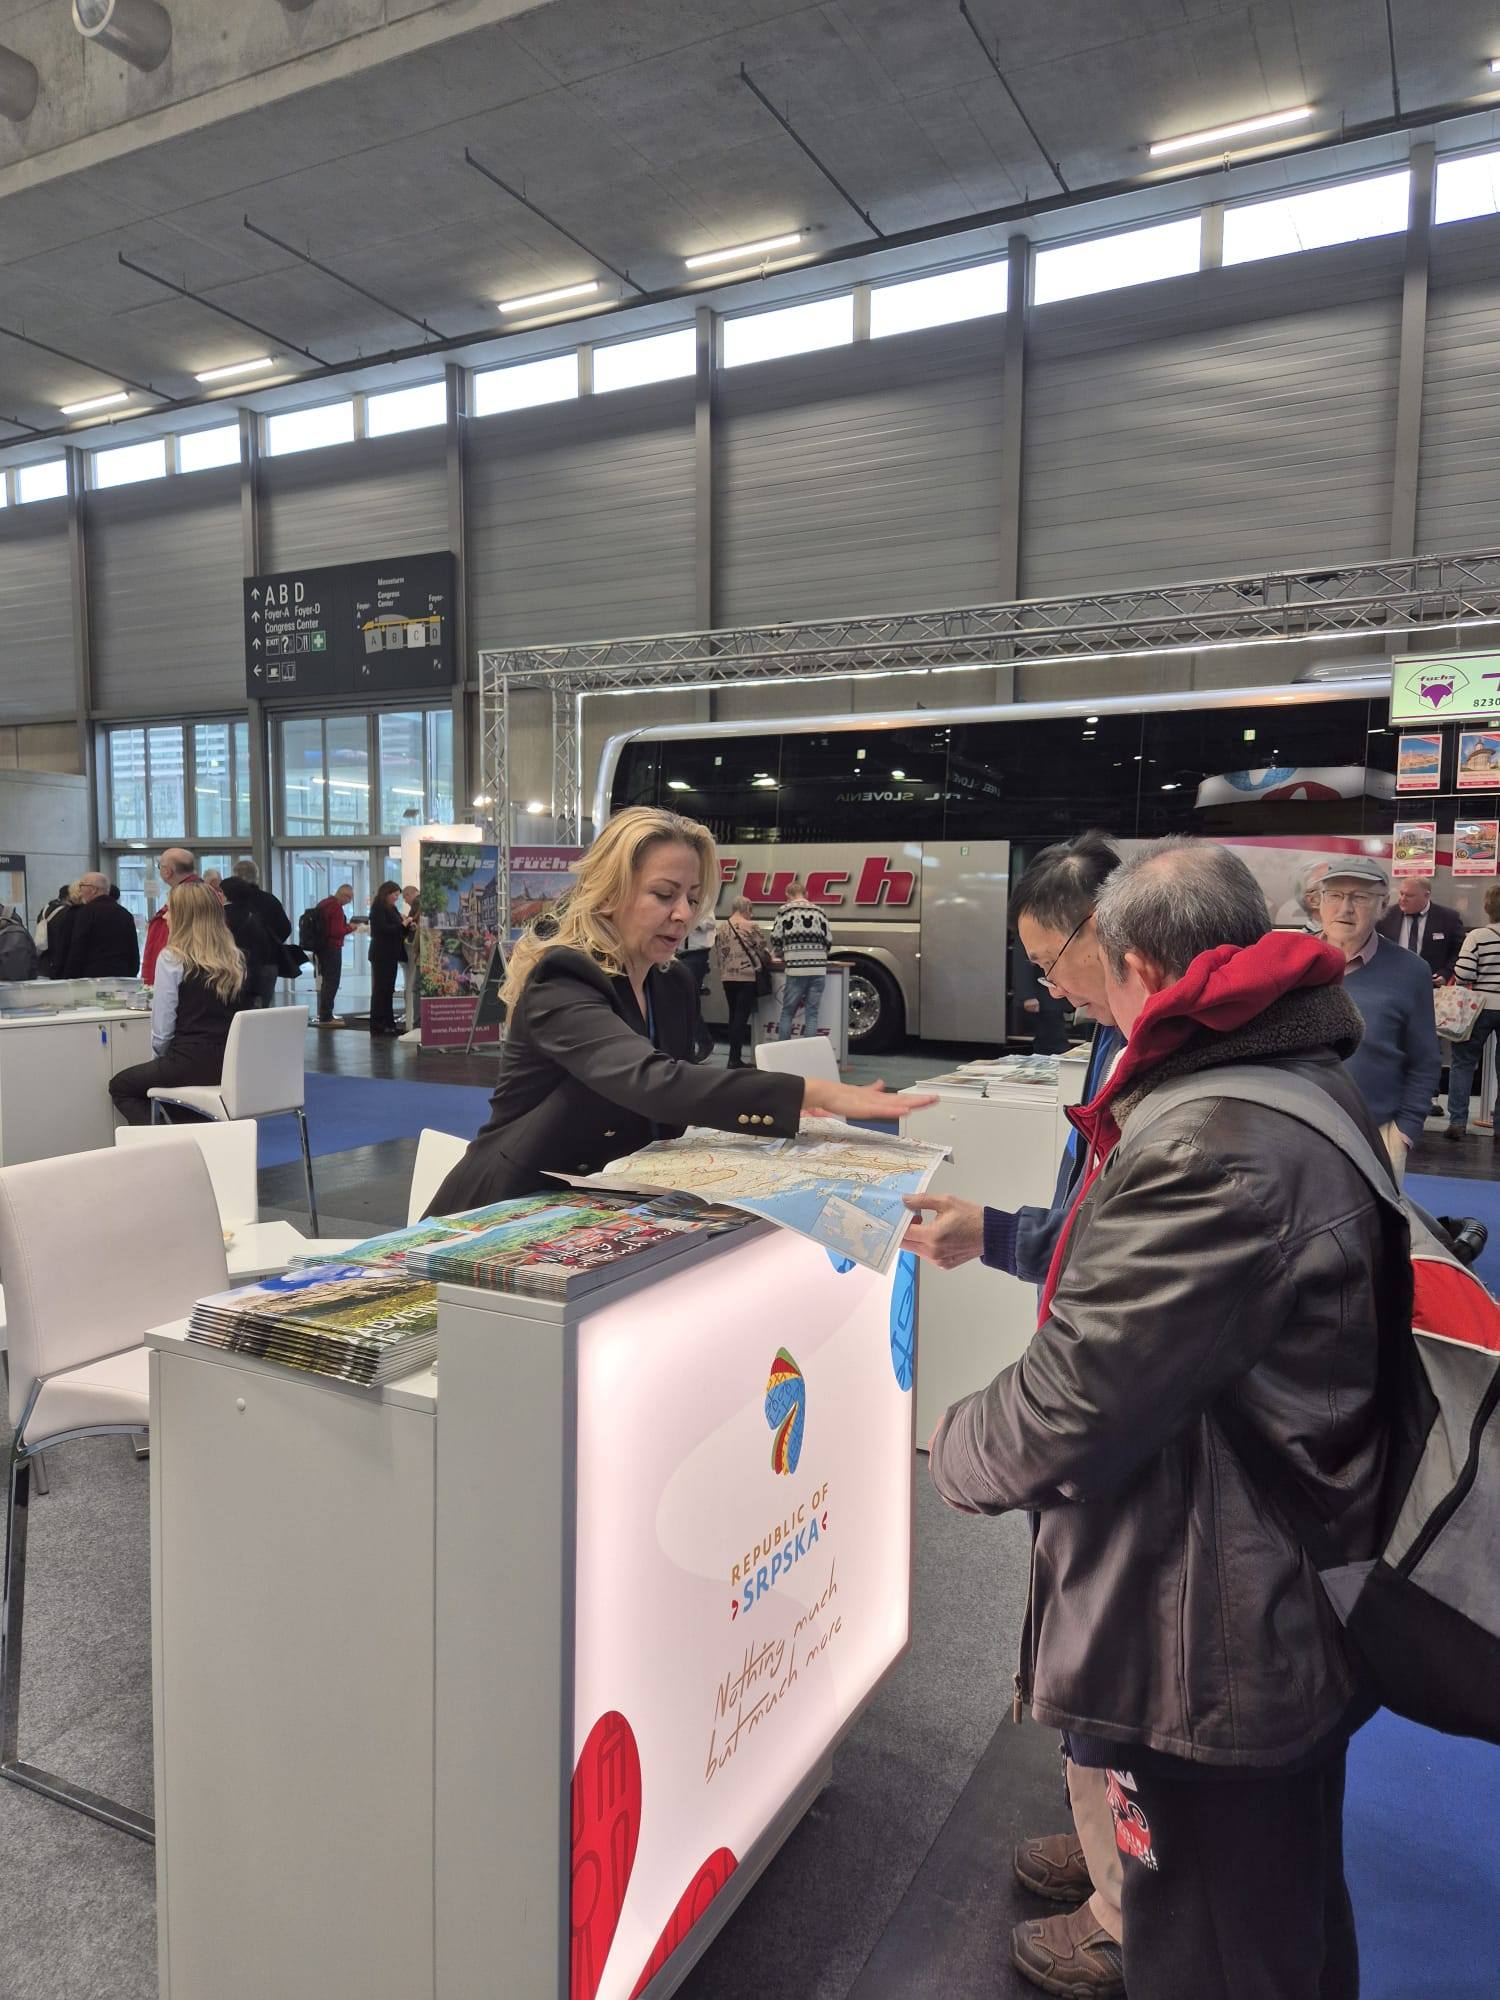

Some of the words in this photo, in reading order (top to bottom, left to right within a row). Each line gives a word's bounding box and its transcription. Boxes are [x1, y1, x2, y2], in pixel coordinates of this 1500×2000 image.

[264, 606, 290, 621] Foyer-A
[294, 602, 321, 618] Foyer-D
[265, 585, 276, 606] A
[279, 583, 288, 605] B
[294, 582, 304, 603] D
[264, 622, 296, 635] Congress
[296, 618, 319, 630] Center
[423, 854, 497, 869] fuchs
[732, 1503, 805, 1586] REPUBLIC
[811, 1481, 829, 1511] OF
[742, 1517, 819, 1614] SRPSKA
[714, 1639, 786, 1724] Nothing
[793, 1556, 838, 1638] much
[748, 1640, 798, 1735] much
[805, 1615, 842, 1668] more
